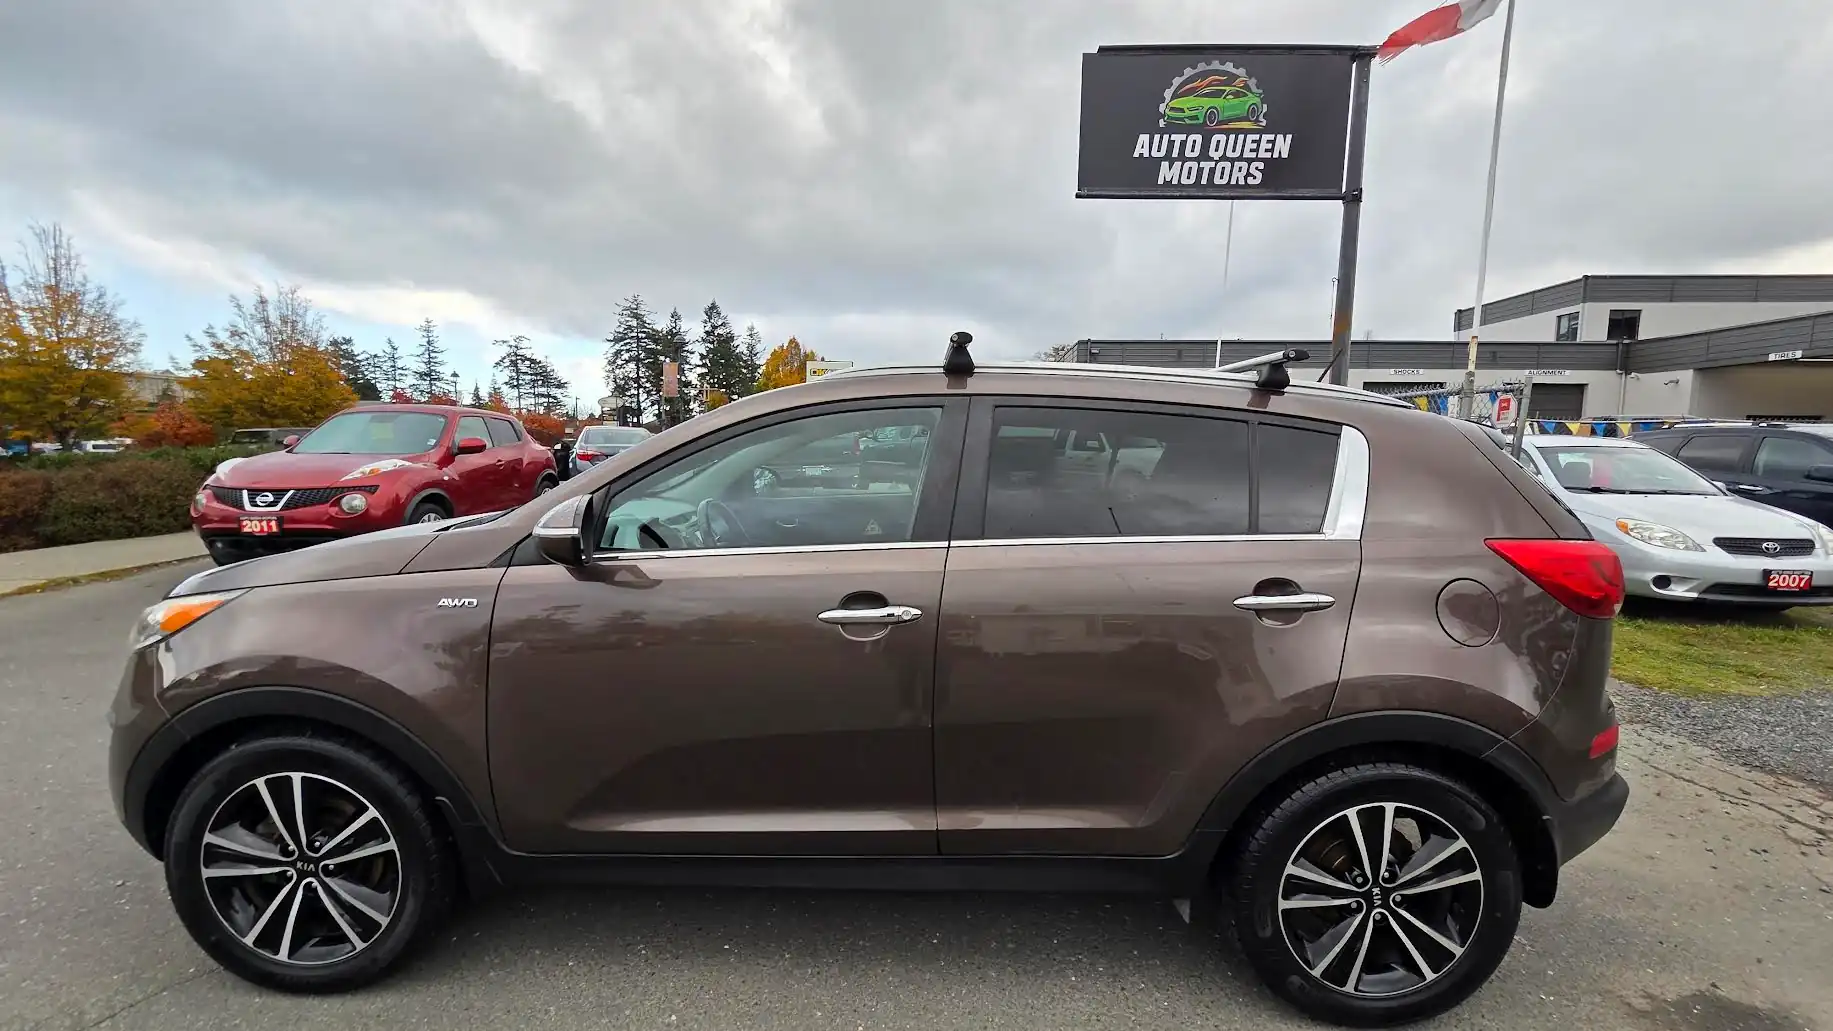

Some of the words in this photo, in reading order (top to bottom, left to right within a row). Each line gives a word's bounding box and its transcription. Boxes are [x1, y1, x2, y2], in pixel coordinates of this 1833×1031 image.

[1133, 134, 1202, 158] AUTO
[1209, 134, 1292, 160] QUEEN
[1158, 161, 1265, 185] MOTORS
[242, 520, 278, 532] 2011
[1768, 574, 1810, 588] 2007
[437, 598, 478, 608] AWD
[296, 860, 316, 872] KIA
[1371, 887, 1382, 907] KIA
